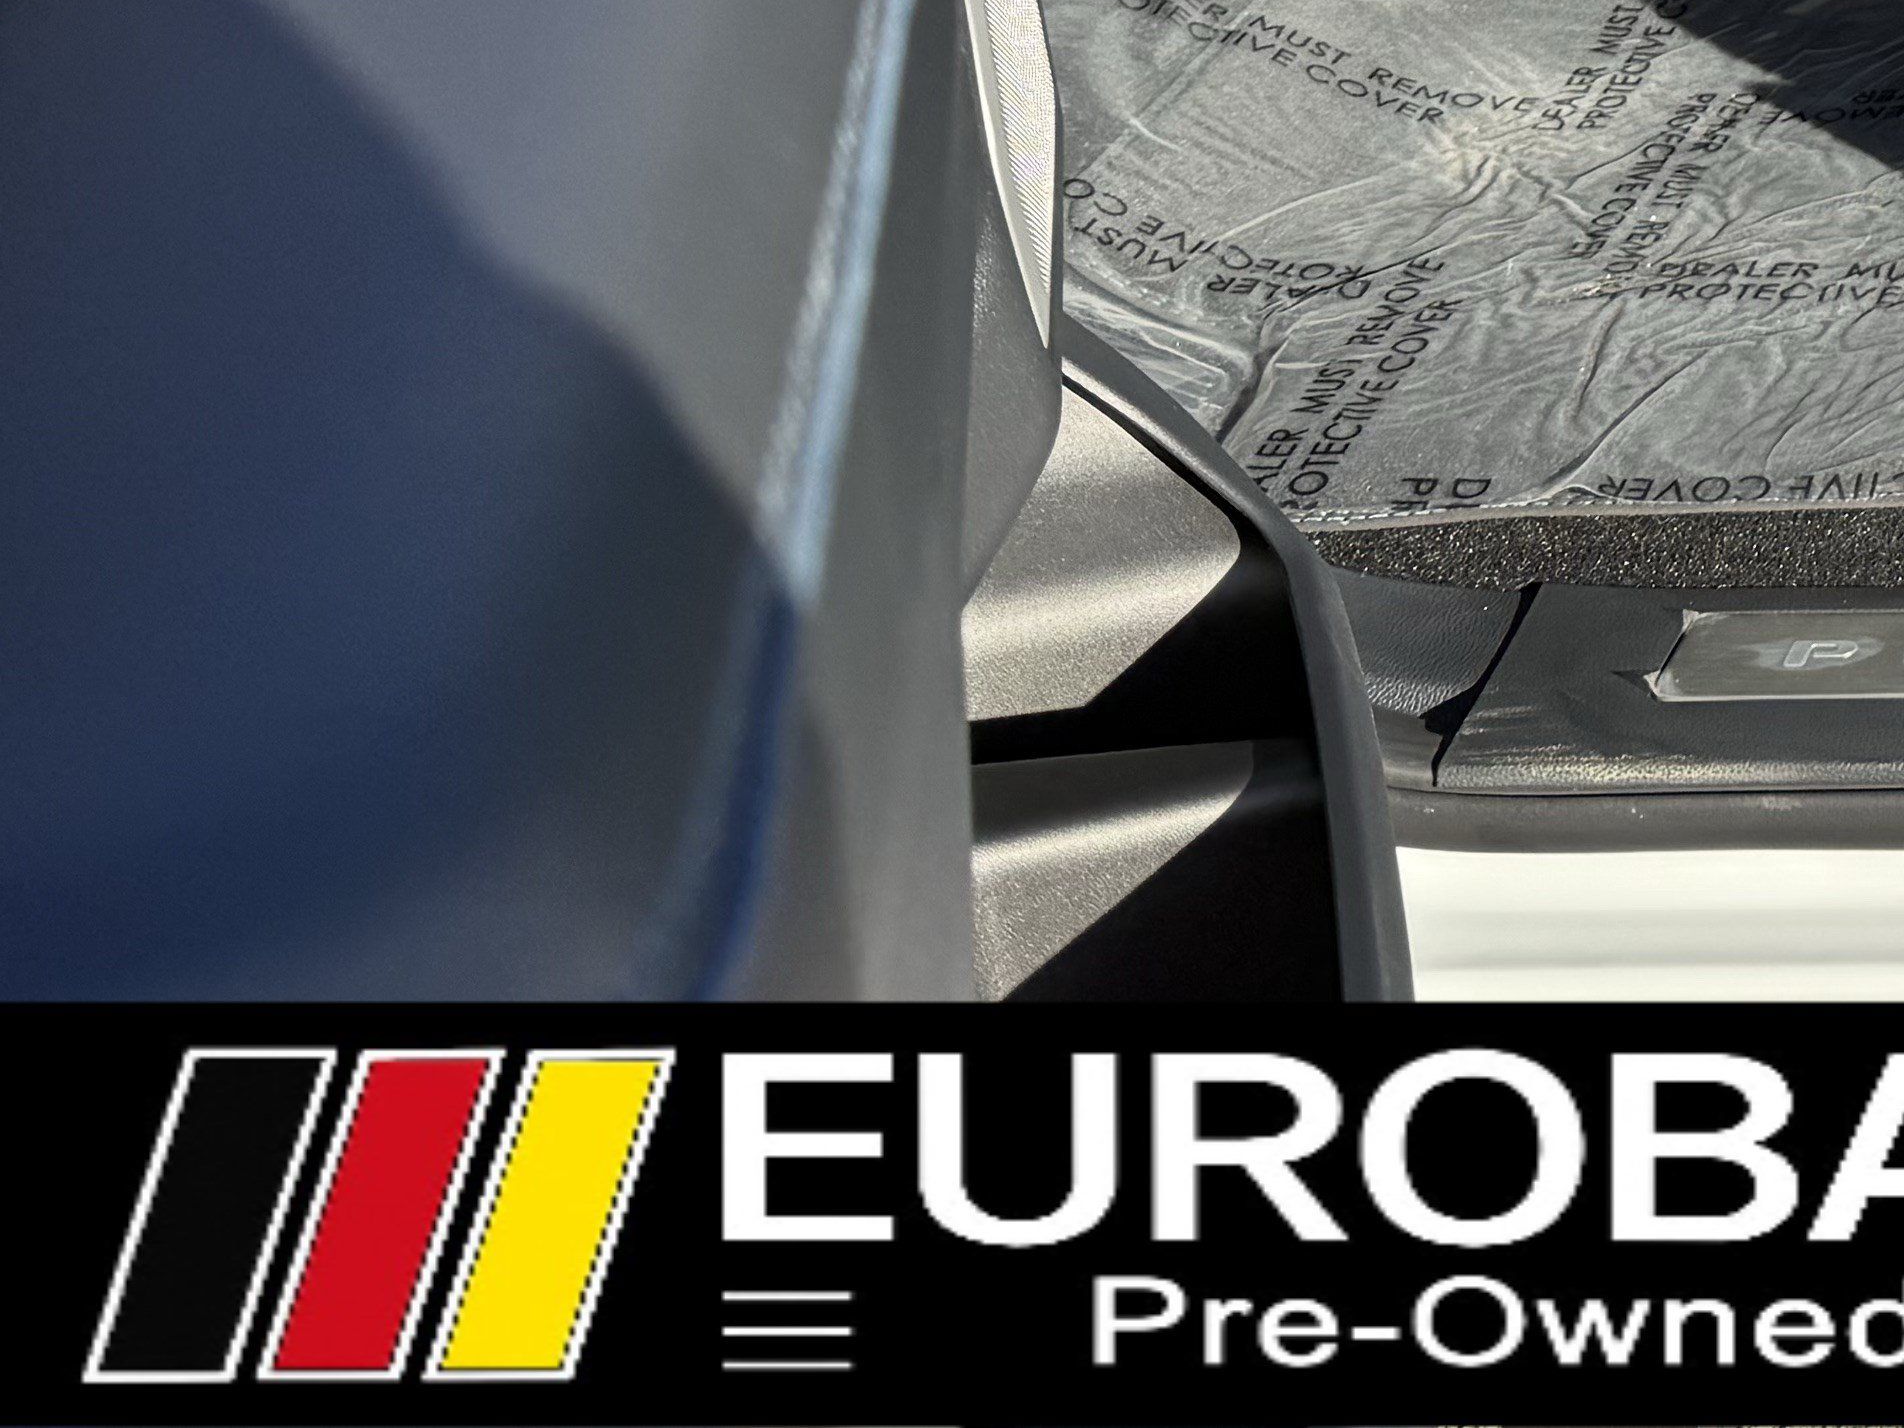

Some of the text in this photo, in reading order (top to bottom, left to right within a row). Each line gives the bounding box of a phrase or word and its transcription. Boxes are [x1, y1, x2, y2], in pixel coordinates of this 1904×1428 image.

[1249, 14, 1356, 65] MUST
[1369, 67, 1541, 114] REMOVE
[1305, 64, 1447, 124] COVER
[1537, 65, 1605, 132] DEALER
[1598, 2, 1645, 56] MUST
[1578, 24, 1679, 130] PROTECTIVE
[1074, 216, 1372, 302] DALER MUST
[1135, 214, 1366, 282] ROTECTIVE
[1639, 280, 1904, 306] PROTECTIVE
[1659, 259, 1820, 282] DEALER
[1290, 359, 1357, 414] MUST
[1346, 256, 1446, 347] REMOVE
[1279, 377, 1400, 510] OTECTIVE
[1378, 297, 1466, 375] COVER
